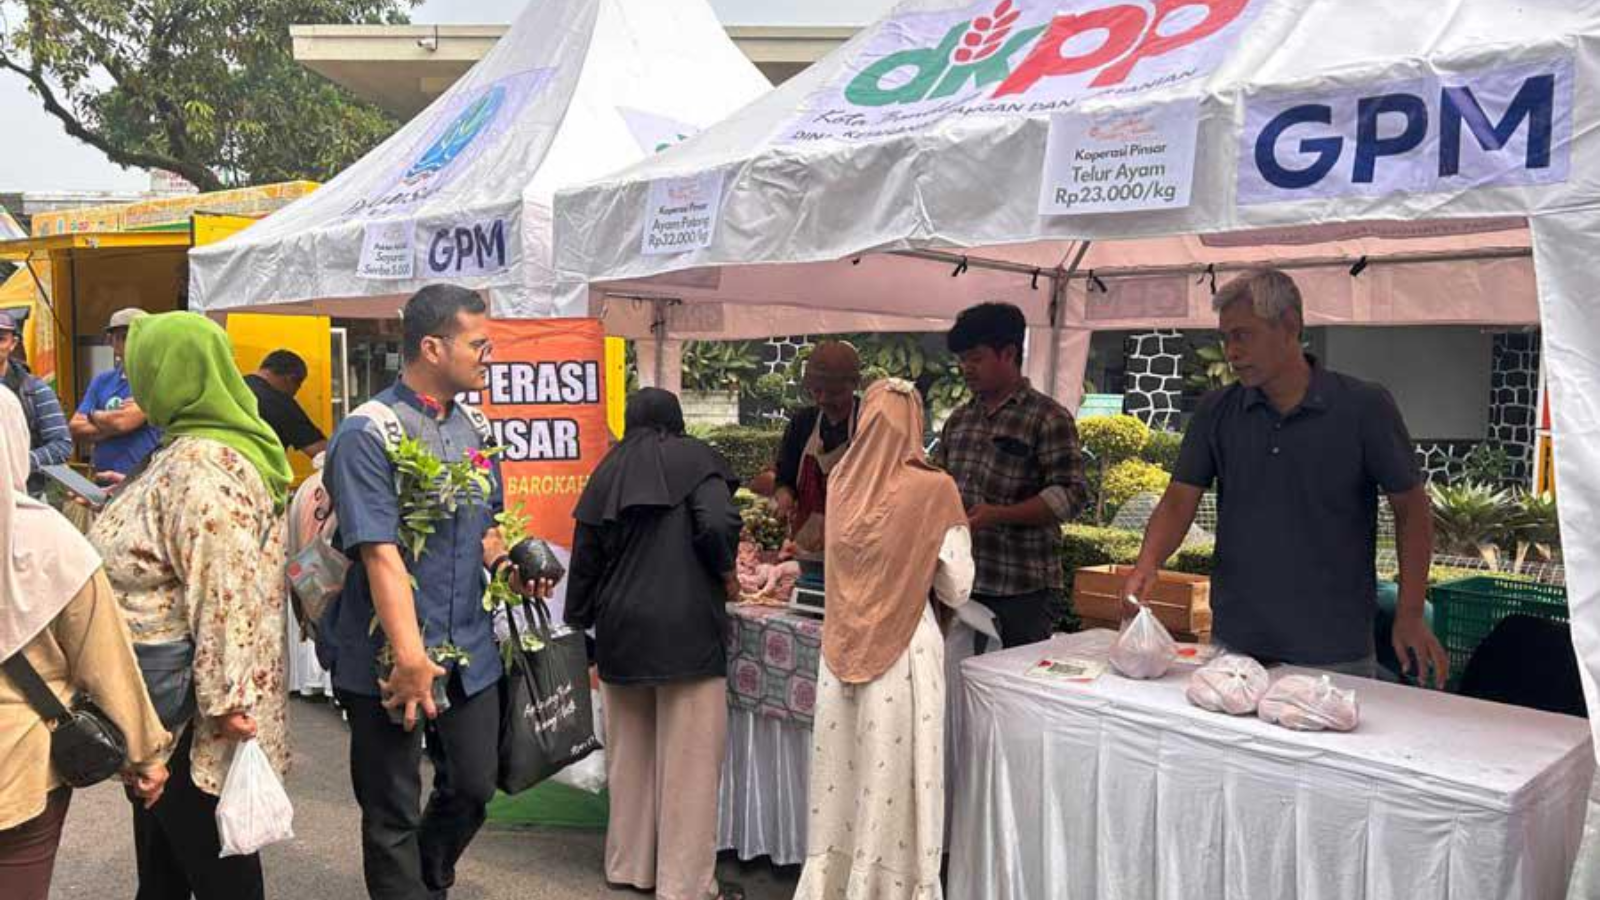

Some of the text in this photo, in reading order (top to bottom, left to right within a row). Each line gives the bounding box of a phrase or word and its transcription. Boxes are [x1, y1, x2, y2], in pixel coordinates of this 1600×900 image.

[1254, 73, 1555, 189] GPM
[1074, 142, 1167, 163] Koperasi Pinsar
[1072, 163, 1166, 183] Telur Ayam
[1055, 180, 1176, 208] Rp23.000/kg
[428, 219, 505, 272] GPM
